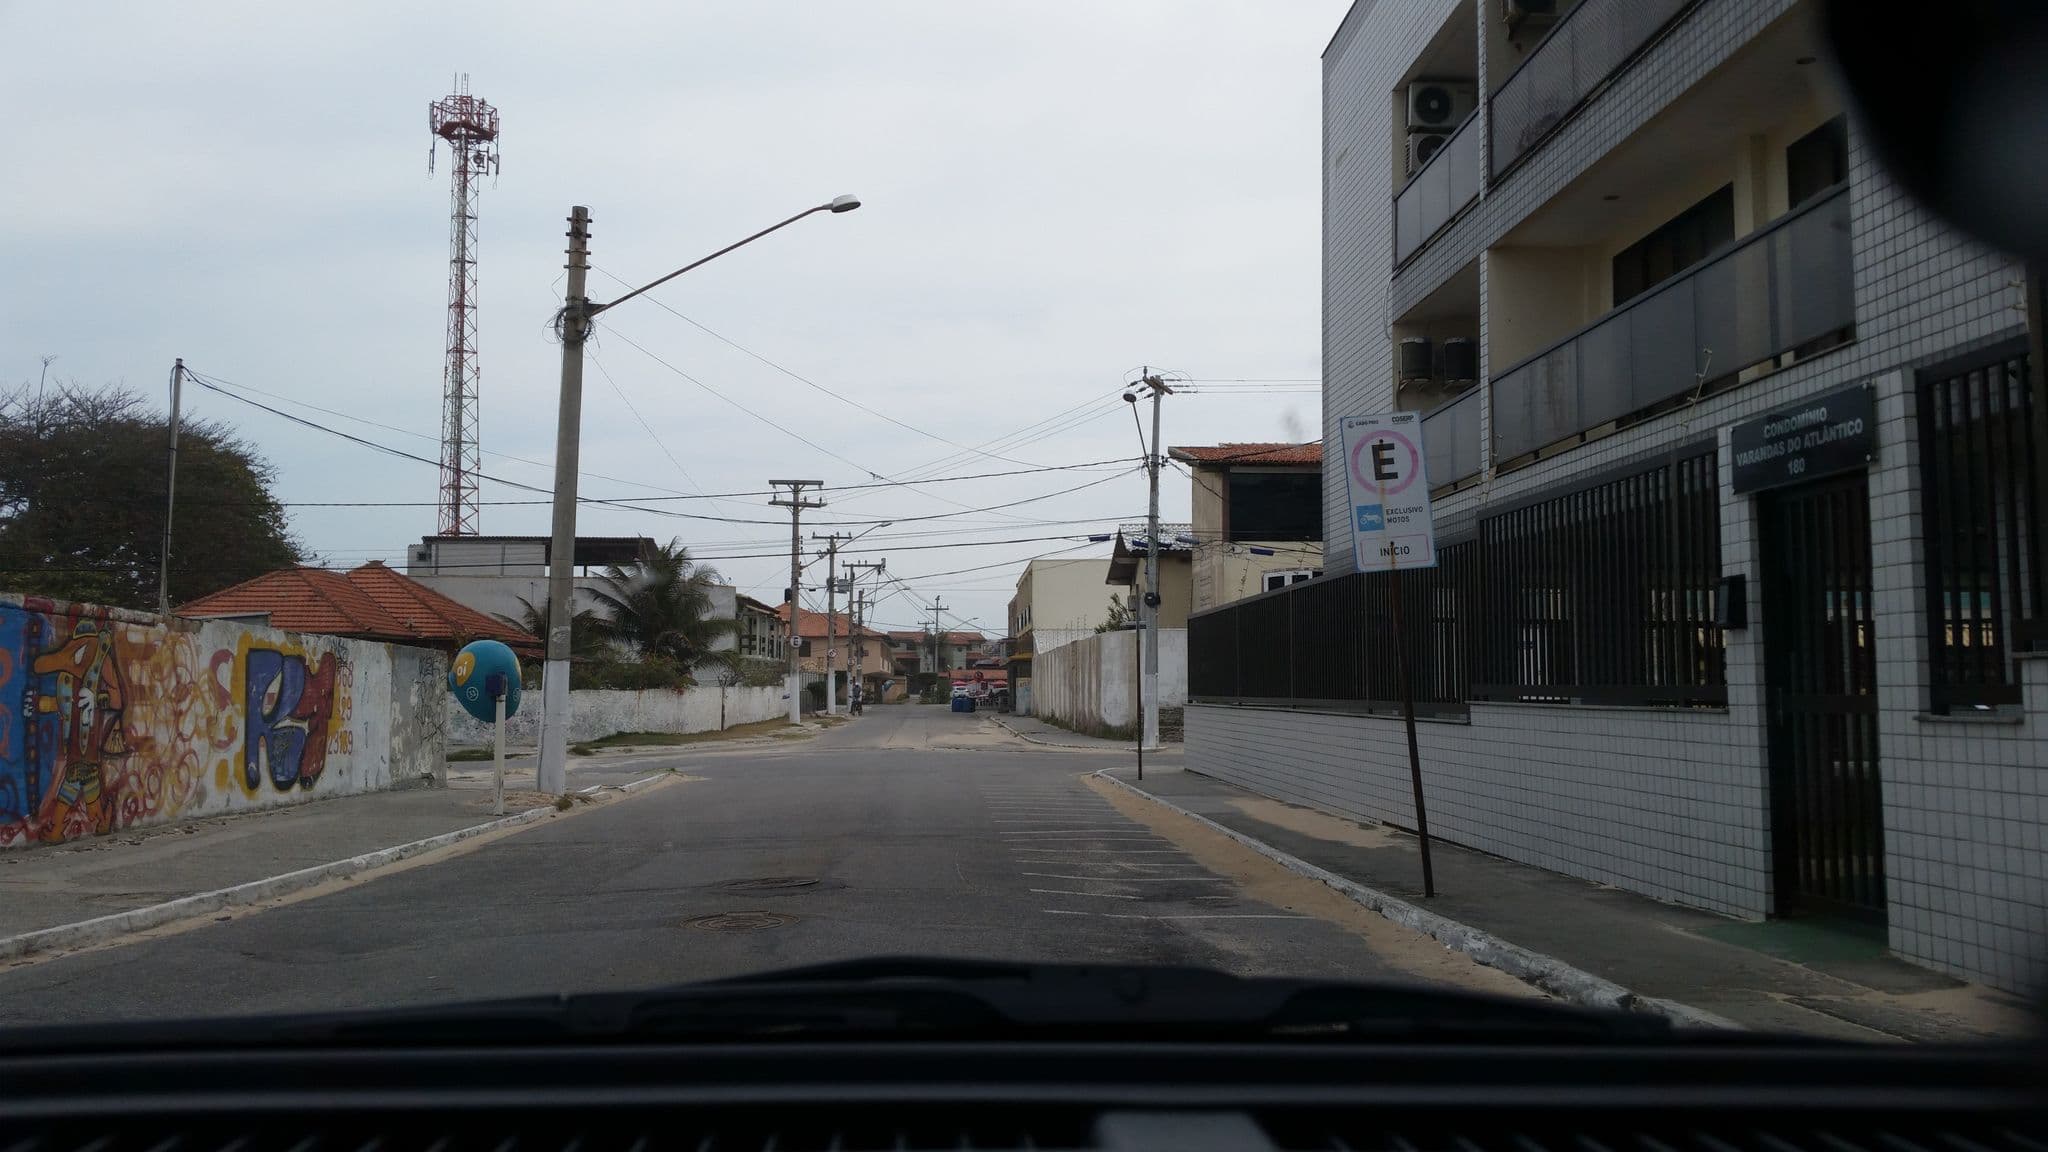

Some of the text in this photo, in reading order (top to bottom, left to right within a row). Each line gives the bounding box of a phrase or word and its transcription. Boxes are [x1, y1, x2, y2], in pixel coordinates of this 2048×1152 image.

[1764, 407, 1827, 438] CONDOMÍNIO
[1736, 441, 1786, 467] VARANDAS
[1787, 436, 1801, 454] DO
[1372, 443, 1398, 480] E
[1788, 457, 1806, 475] 180
[1386, 505, 1424, 515] EXCLUSIVO
[1386, 515, 1411, 524] MOTOS
[456, 660, 468, 677] oi
